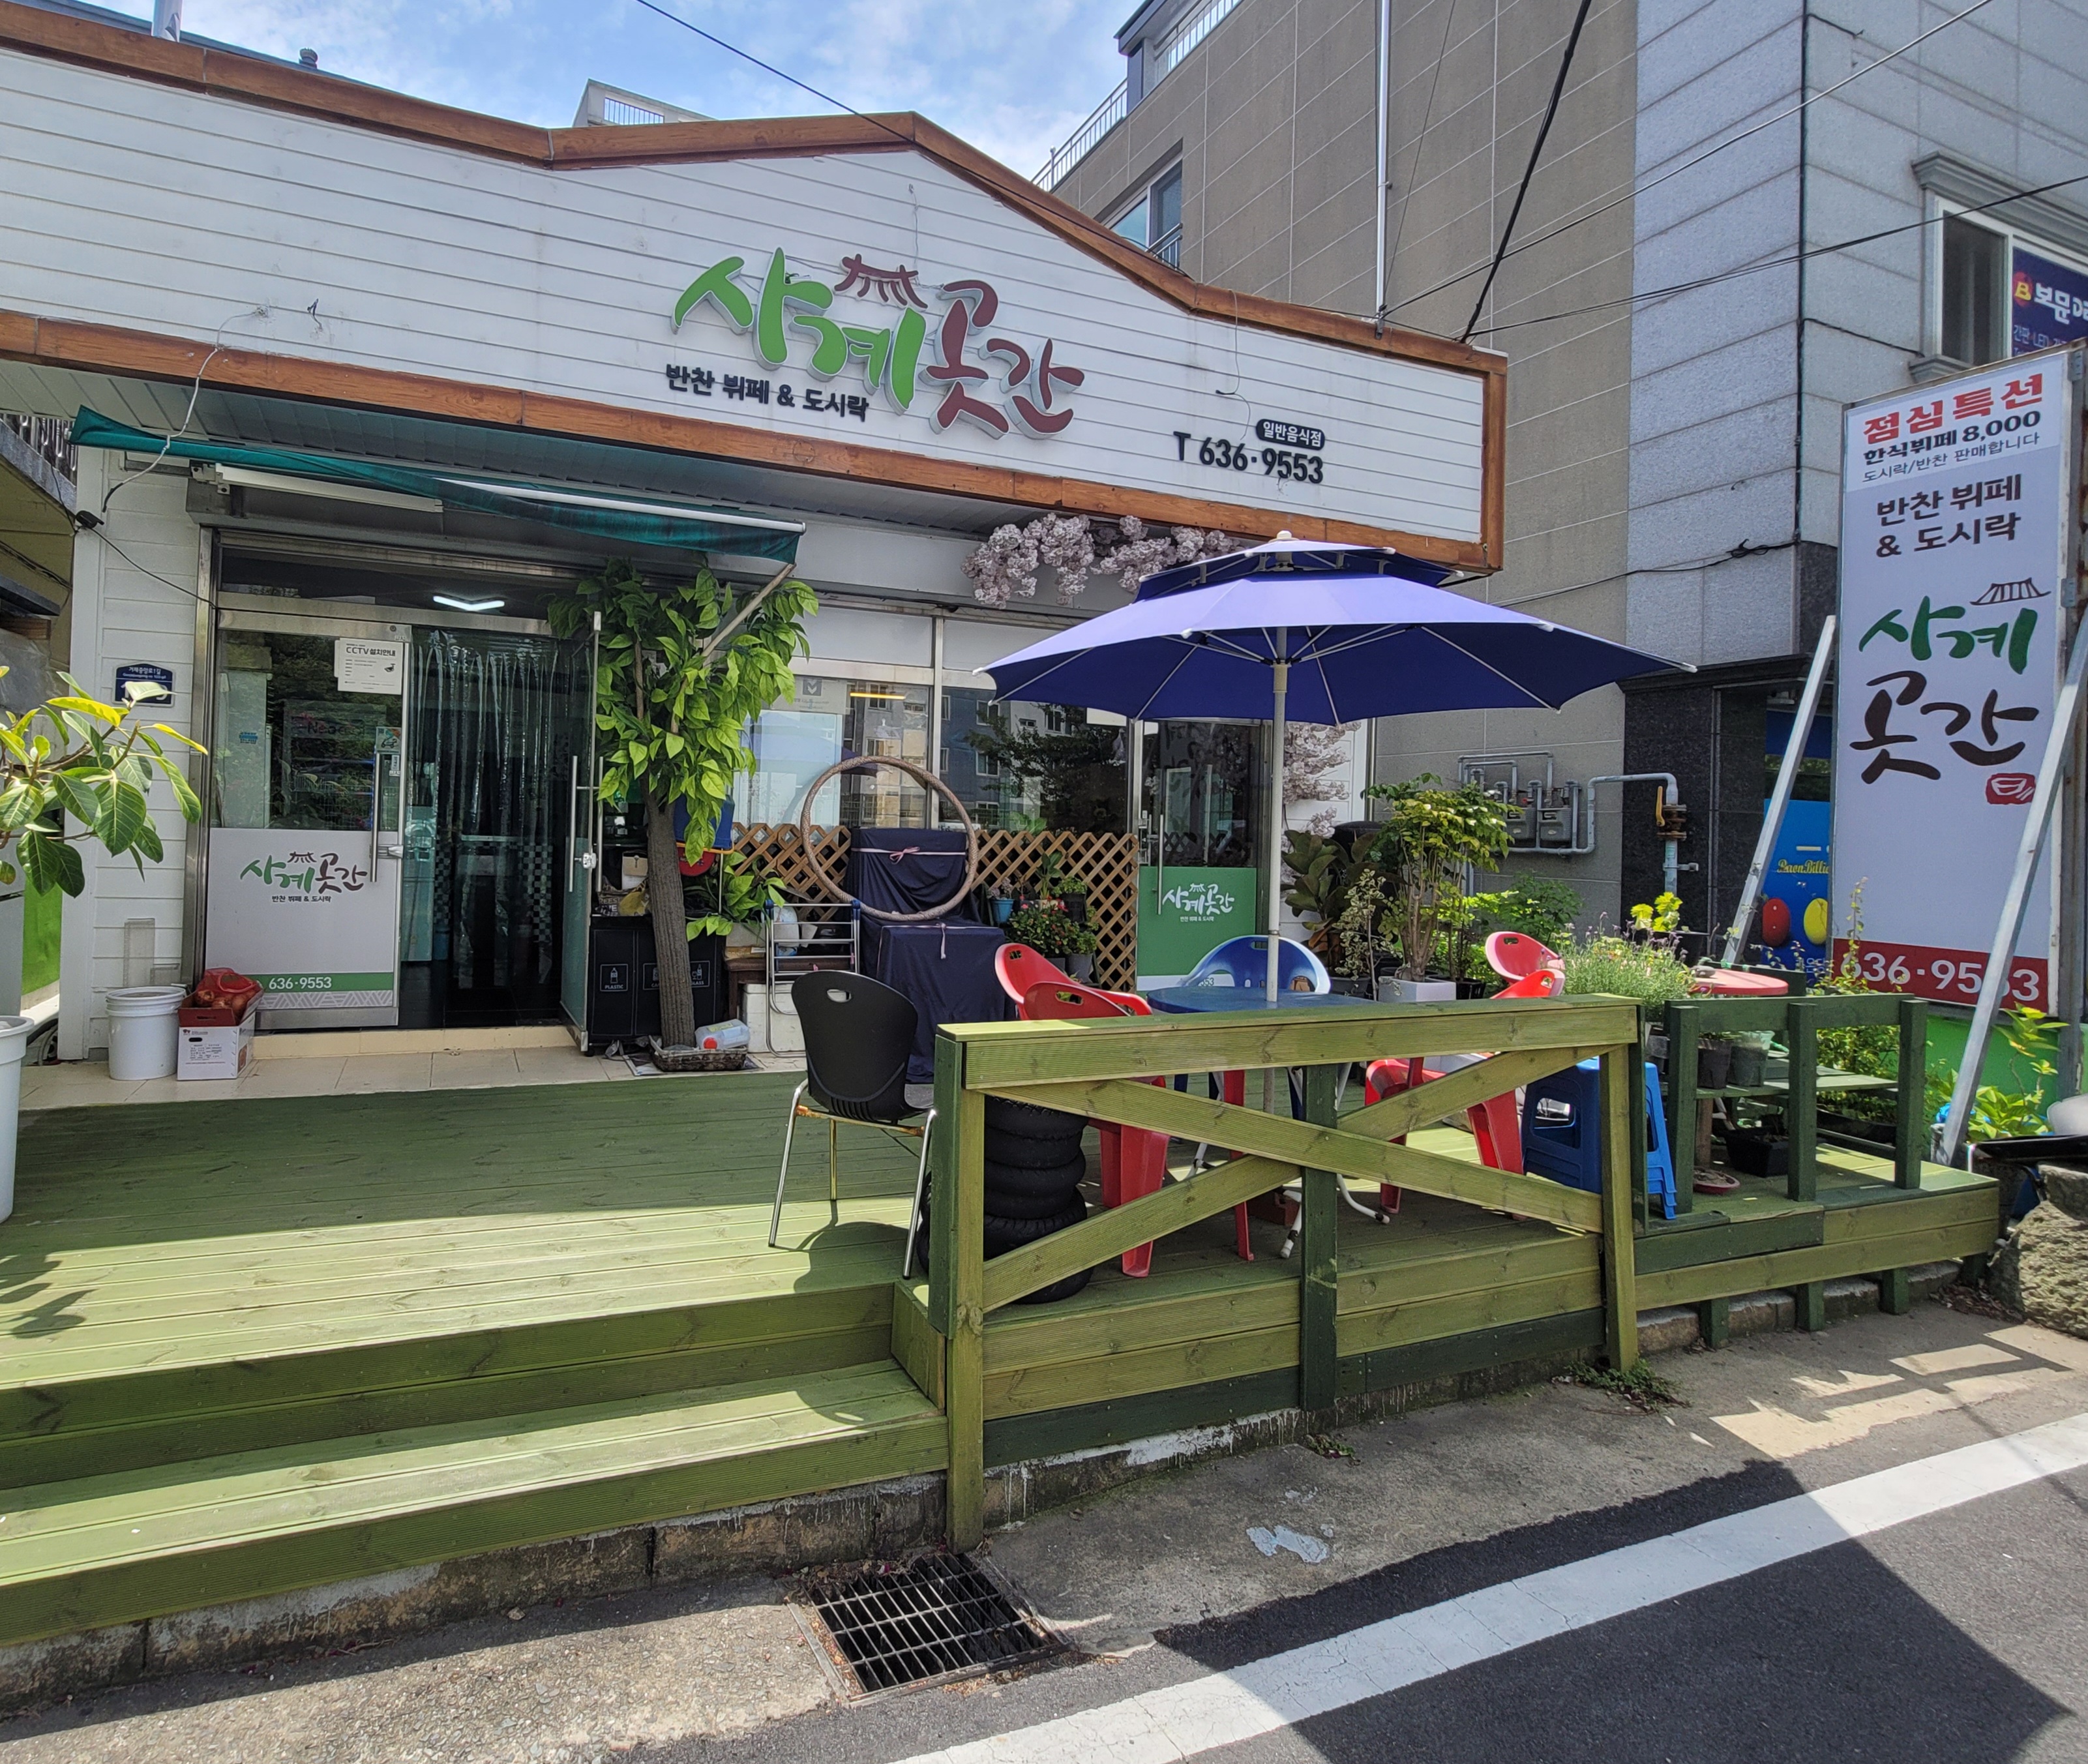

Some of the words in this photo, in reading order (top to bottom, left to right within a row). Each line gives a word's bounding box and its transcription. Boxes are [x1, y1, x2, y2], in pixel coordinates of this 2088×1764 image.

[666, 364, 715, 396] 반찬
[723, 374, 769, 404] 뷔페
[777, 384, 795, 407] &
[803, 389, 869, 423] 도시락
[1863, 373, 2043, 445] 점심특선
[1173, 431, 1191, 461] T
[1262, 421, 1321, 447] 일반음식점
[1862, 453, 1948, 483] 도시락/반찬
[1954, 431, 2040, 462] 판매합니다
[1863, 429, 1957, 466] 한식뷔페
[1961, 411, 2041, 443] 8,000
[1876, 490, 1943, 527] 반찬
[1950, 473, 2021, 511] 뷔페
[1875, 535, 1902, 558] &
[1914, 513, 2021, 552] 도시락
[346, 646, 369, 655] CCTV
[1858, 595, 2038, 675] 사계
[1849, 670, 2039, 785] 곳간
